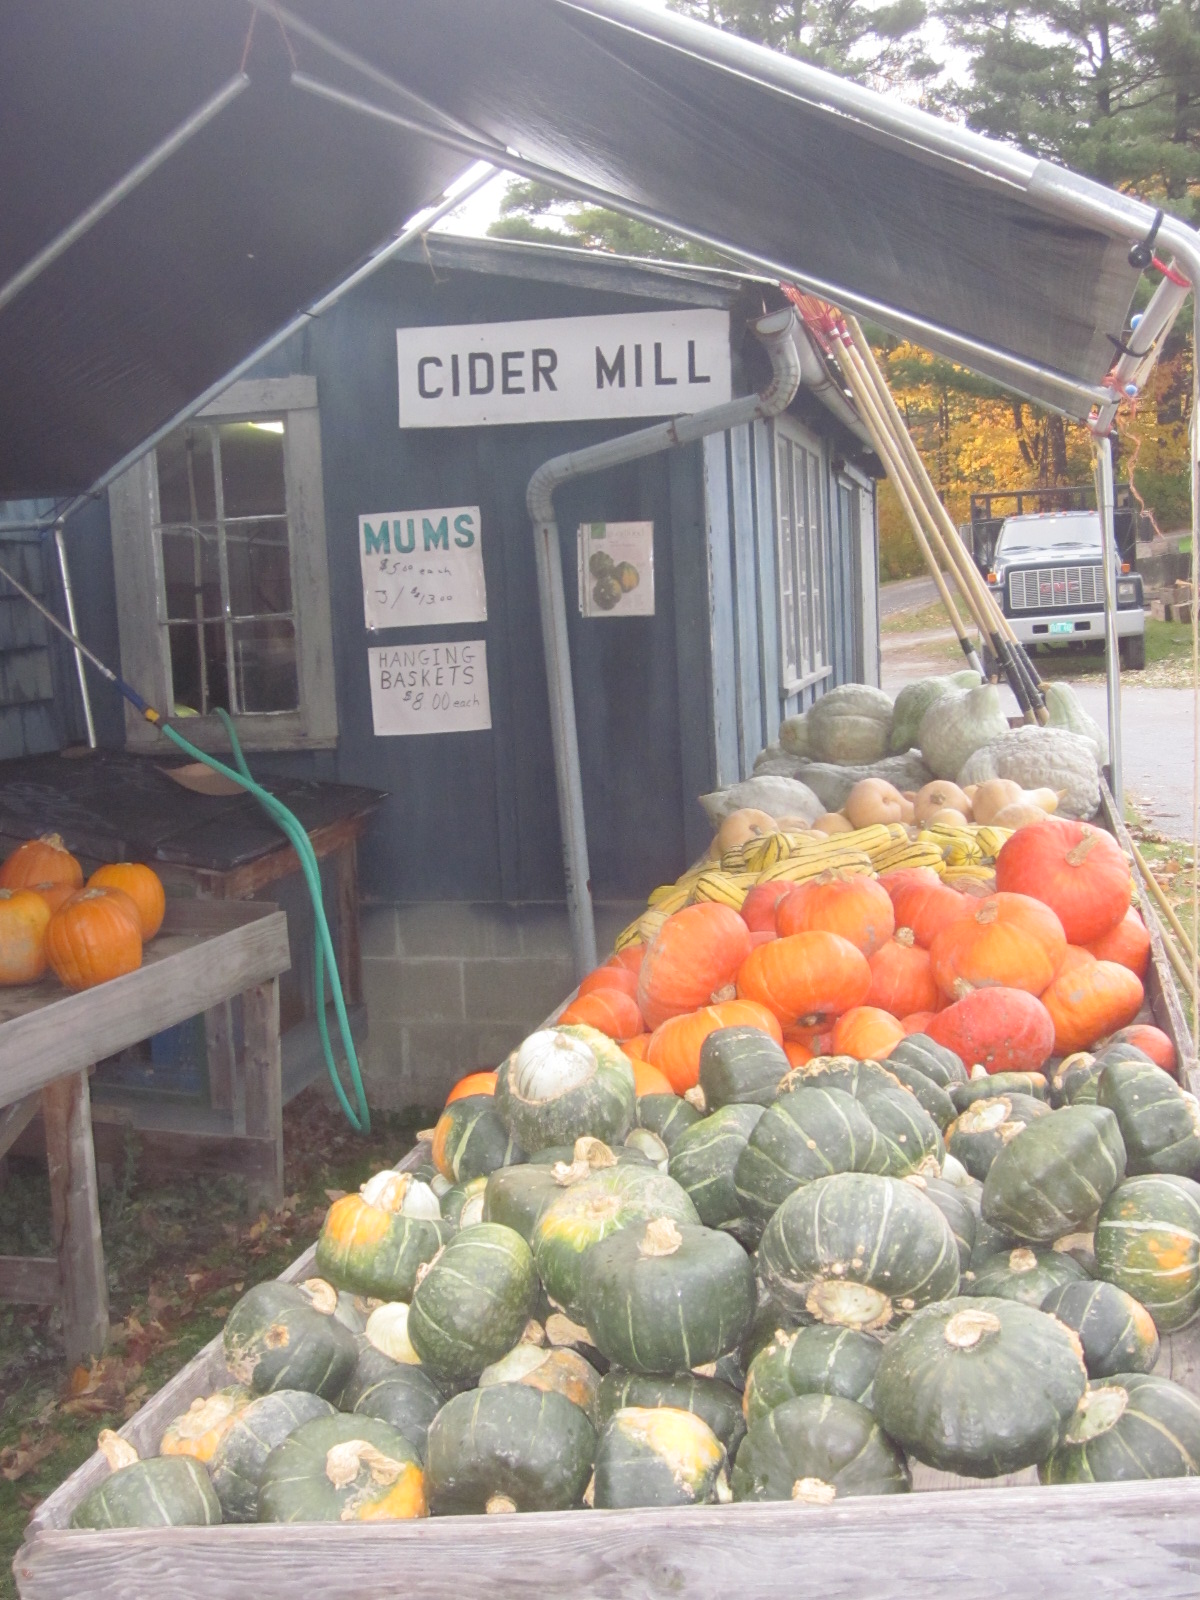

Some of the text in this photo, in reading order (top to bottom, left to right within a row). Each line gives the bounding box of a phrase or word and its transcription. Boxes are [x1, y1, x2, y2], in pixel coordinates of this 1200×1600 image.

[418, 340, 711, 399] CIDER MILL
[363, 513, 475, 556] MUMS
[379, 646, 476, 668] HANGING
[380, 665, 475, 690] BASKETS
[453, 694, 480, 708] each
